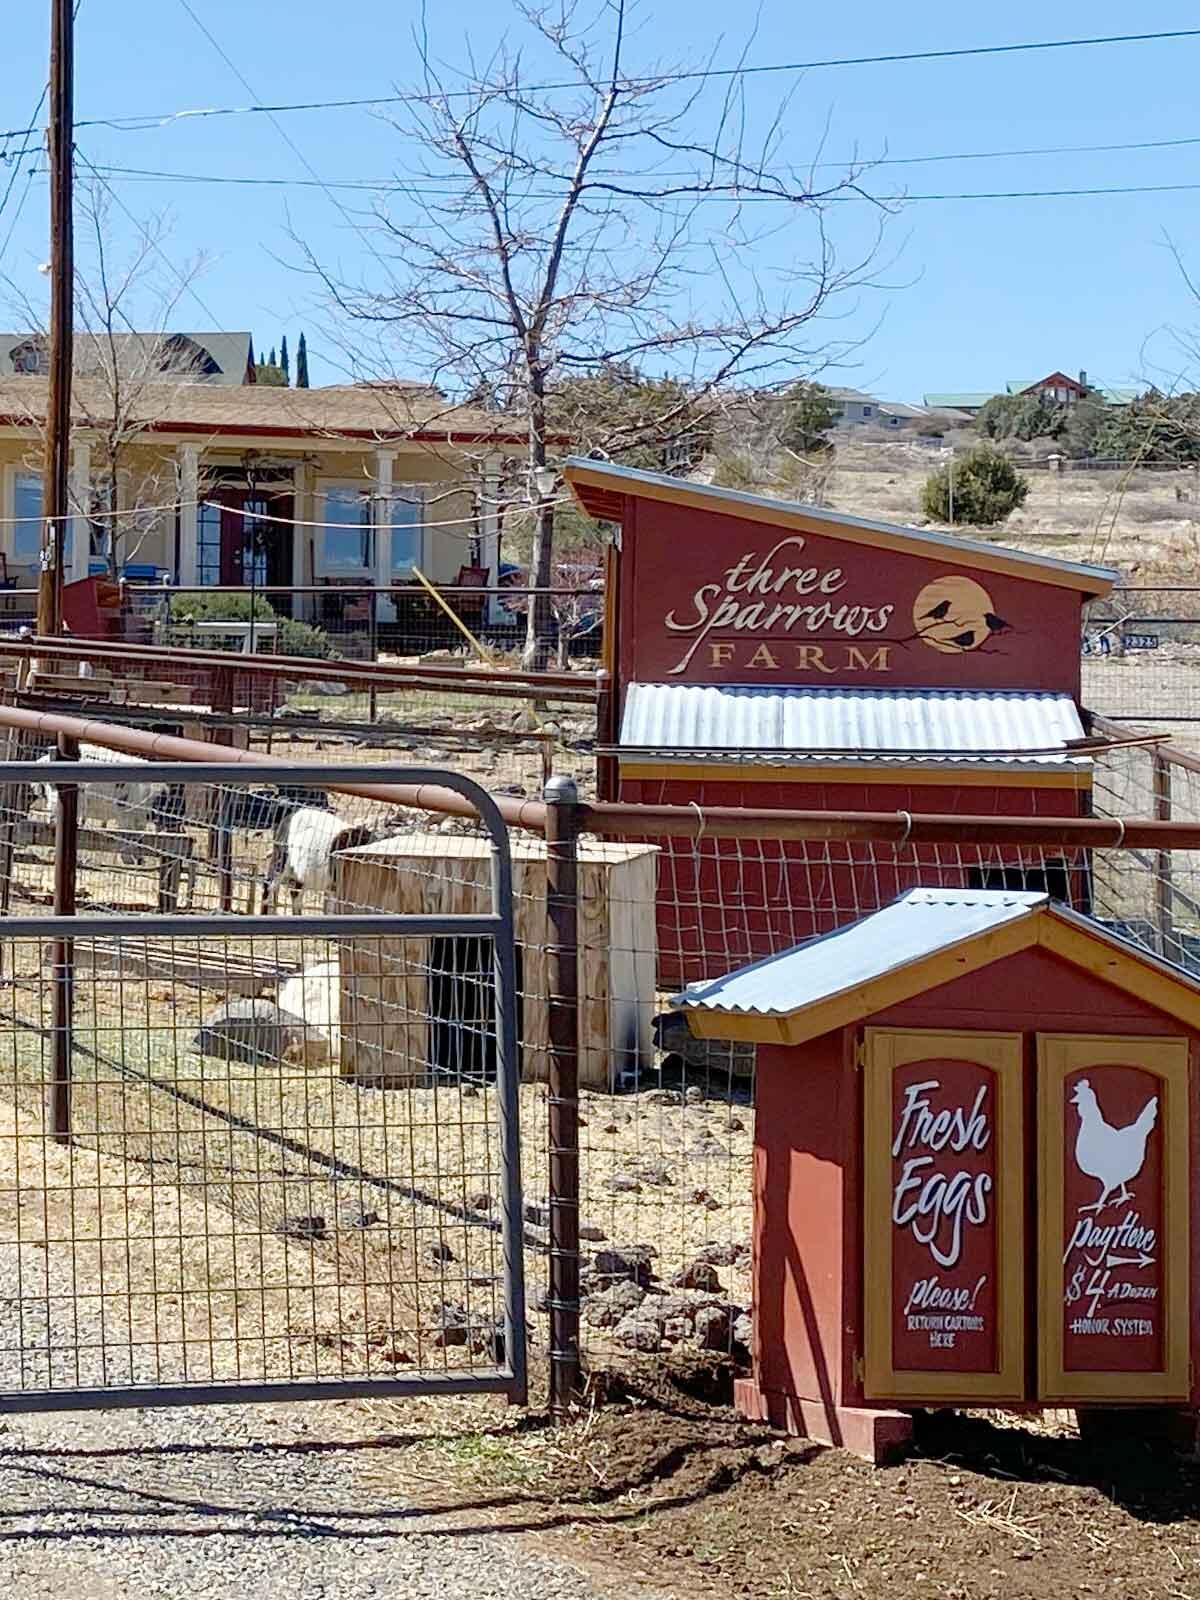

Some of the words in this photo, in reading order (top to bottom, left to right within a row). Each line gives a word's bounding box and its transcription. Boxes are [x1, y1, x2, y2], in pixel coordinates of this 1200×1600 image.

[664, 583, 894, 675] Sparrows
[707, 642, 893, 673] FARM
[891, 1080, 991, 1158] Fresh
[892, 1156, 992, 1267] Eggs
[907, 1315, 944, 1331] RETURN
[1069, 1318, 1111, 1336] HONOR
[1111, 1318, 1154, 1337] SYSTEM
